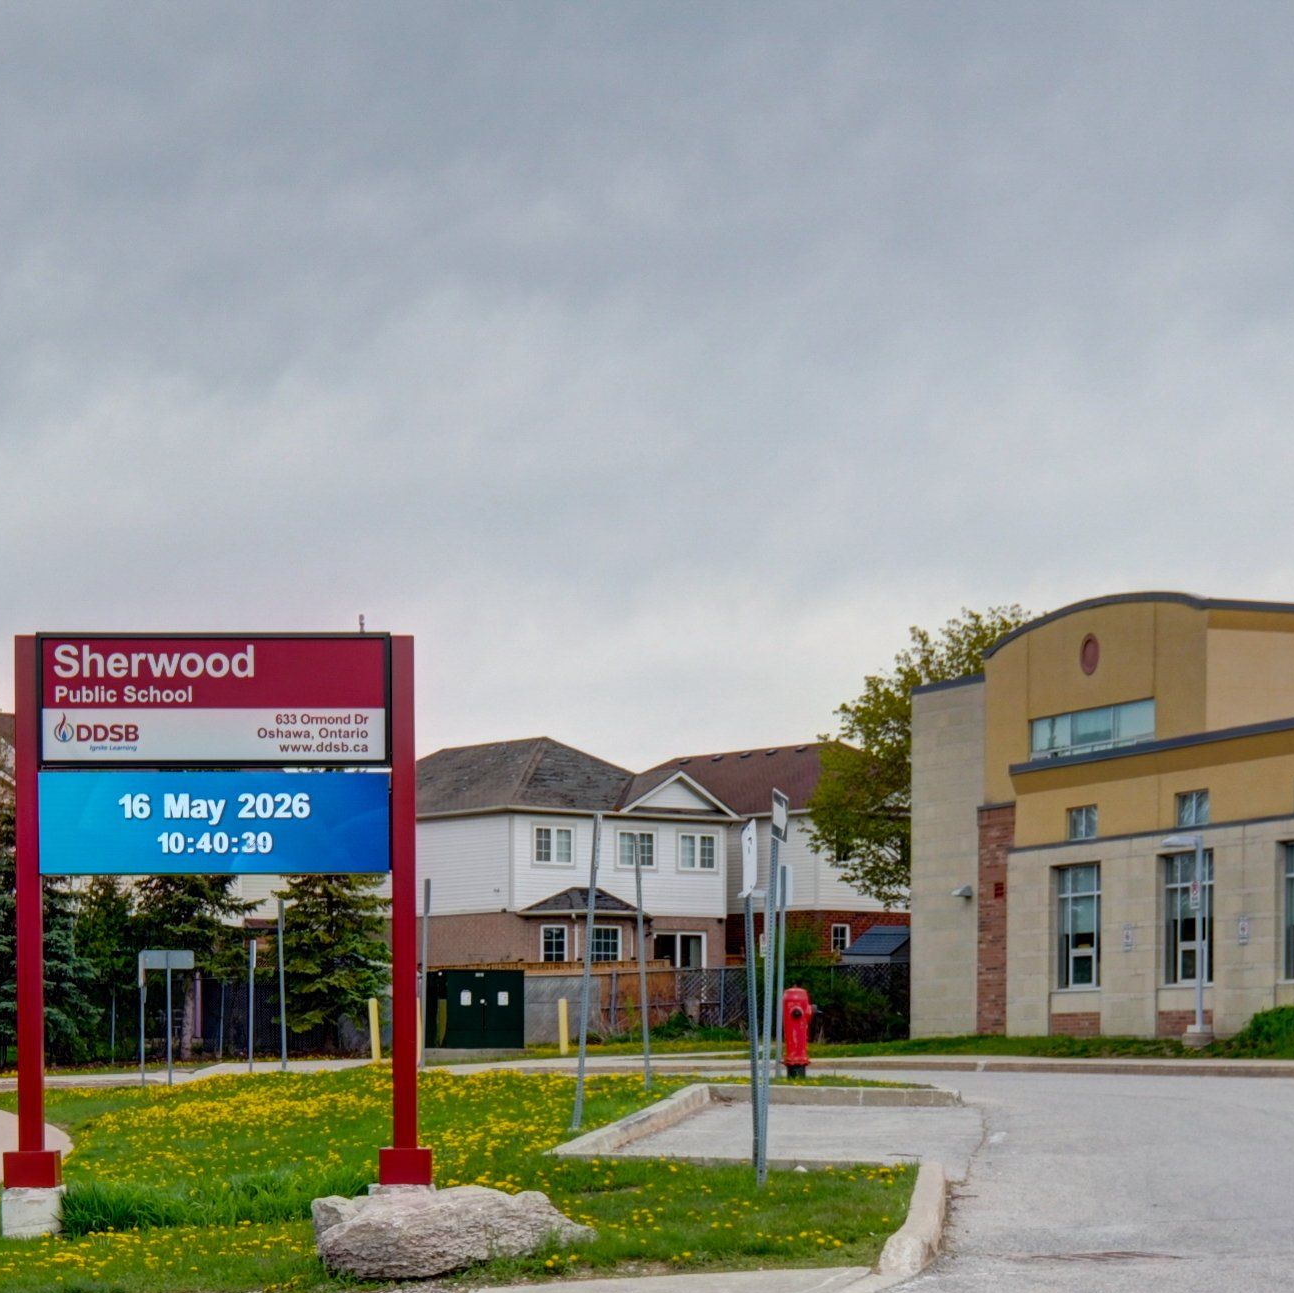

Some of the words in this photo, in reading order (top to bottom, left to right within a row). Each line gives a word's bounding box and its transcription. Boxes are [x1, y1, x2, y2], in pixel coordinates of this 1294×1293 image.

[53, 644, 255, 678] Sherwood
[55, 685, 118, 703] Public
[123, 685, 193, 703] School
[275, 713, 297, 725] 633
[300, 713, 351, 725] Ormond
[354, 713, 369, 725] Dr
[76, 724, 139, 742] DDSB
[257, 727, 315, 740] Oshawa,
[318, 727, 369, 739] Ontario
[279, 741, 369, 753] www.ddsb.ca
[118, 793, 151, 819] 16
[163, 793, 226, 826] May
[237, 792, 311, 819] 2026
